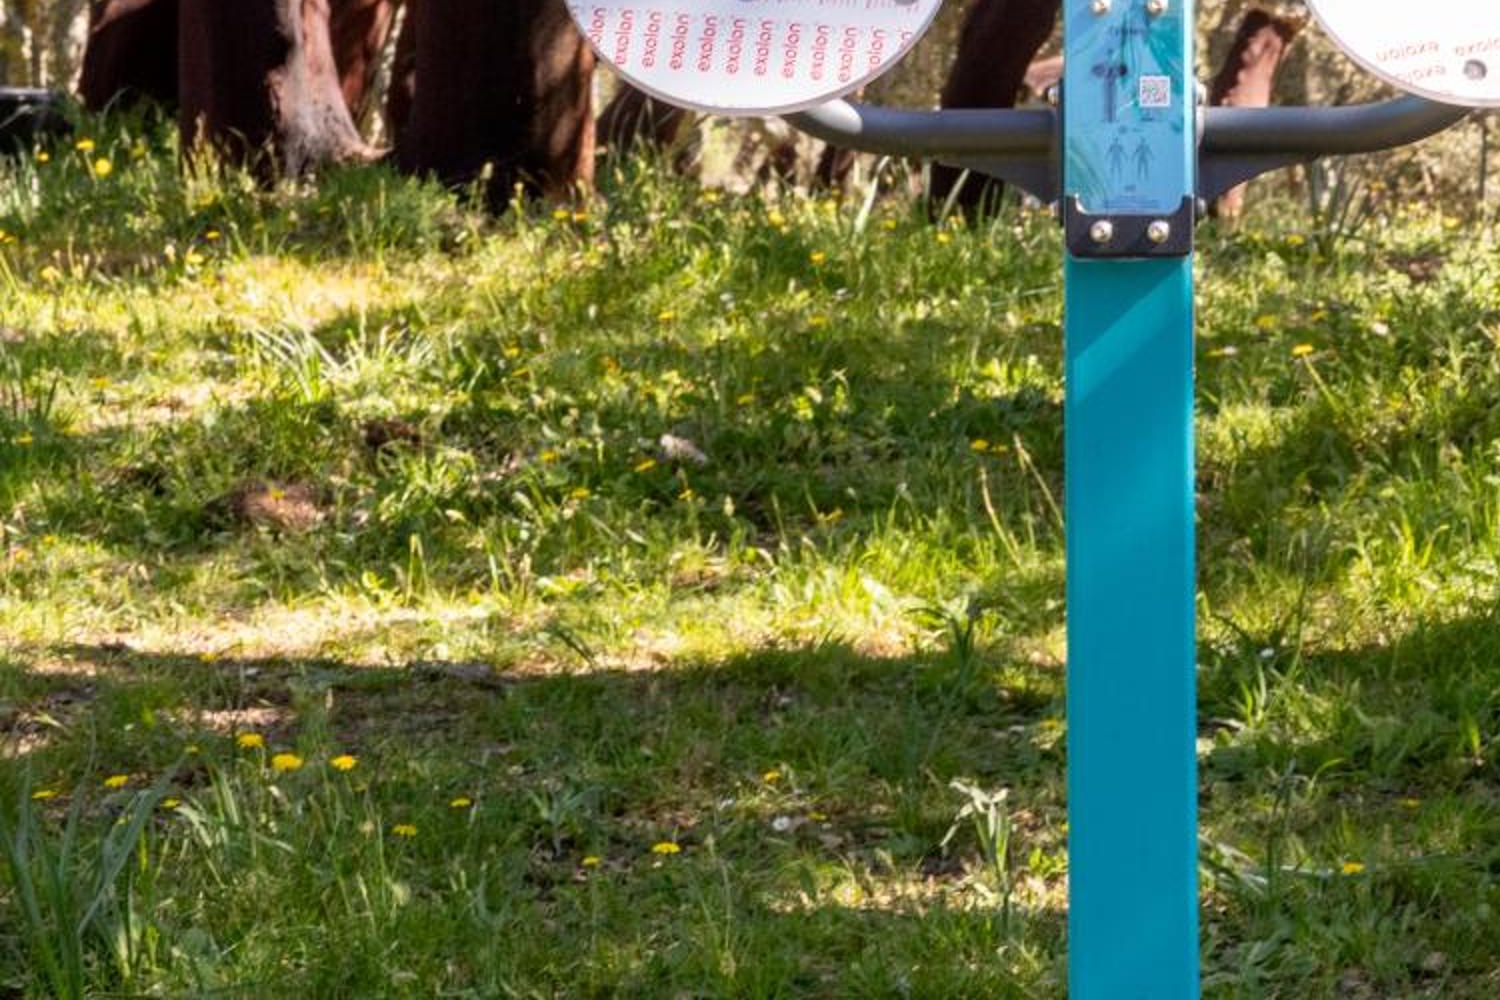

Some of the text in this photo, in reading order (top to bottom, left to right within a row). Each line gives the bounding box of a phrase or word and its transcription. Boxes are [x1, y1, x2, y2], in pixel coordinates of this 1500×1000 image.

[642, 11, 661, 68] exolon
[670, 13, 689, 70] exolon
[698, 15, 717, 72] exolon
[725, 18, 745, 74] exolon
[753, 20, 773, 76] exolon
[782, 22, 801, 78] exolon
[810, 25, 829, 80] exolon
[839, 27, 858, 82] exolon
